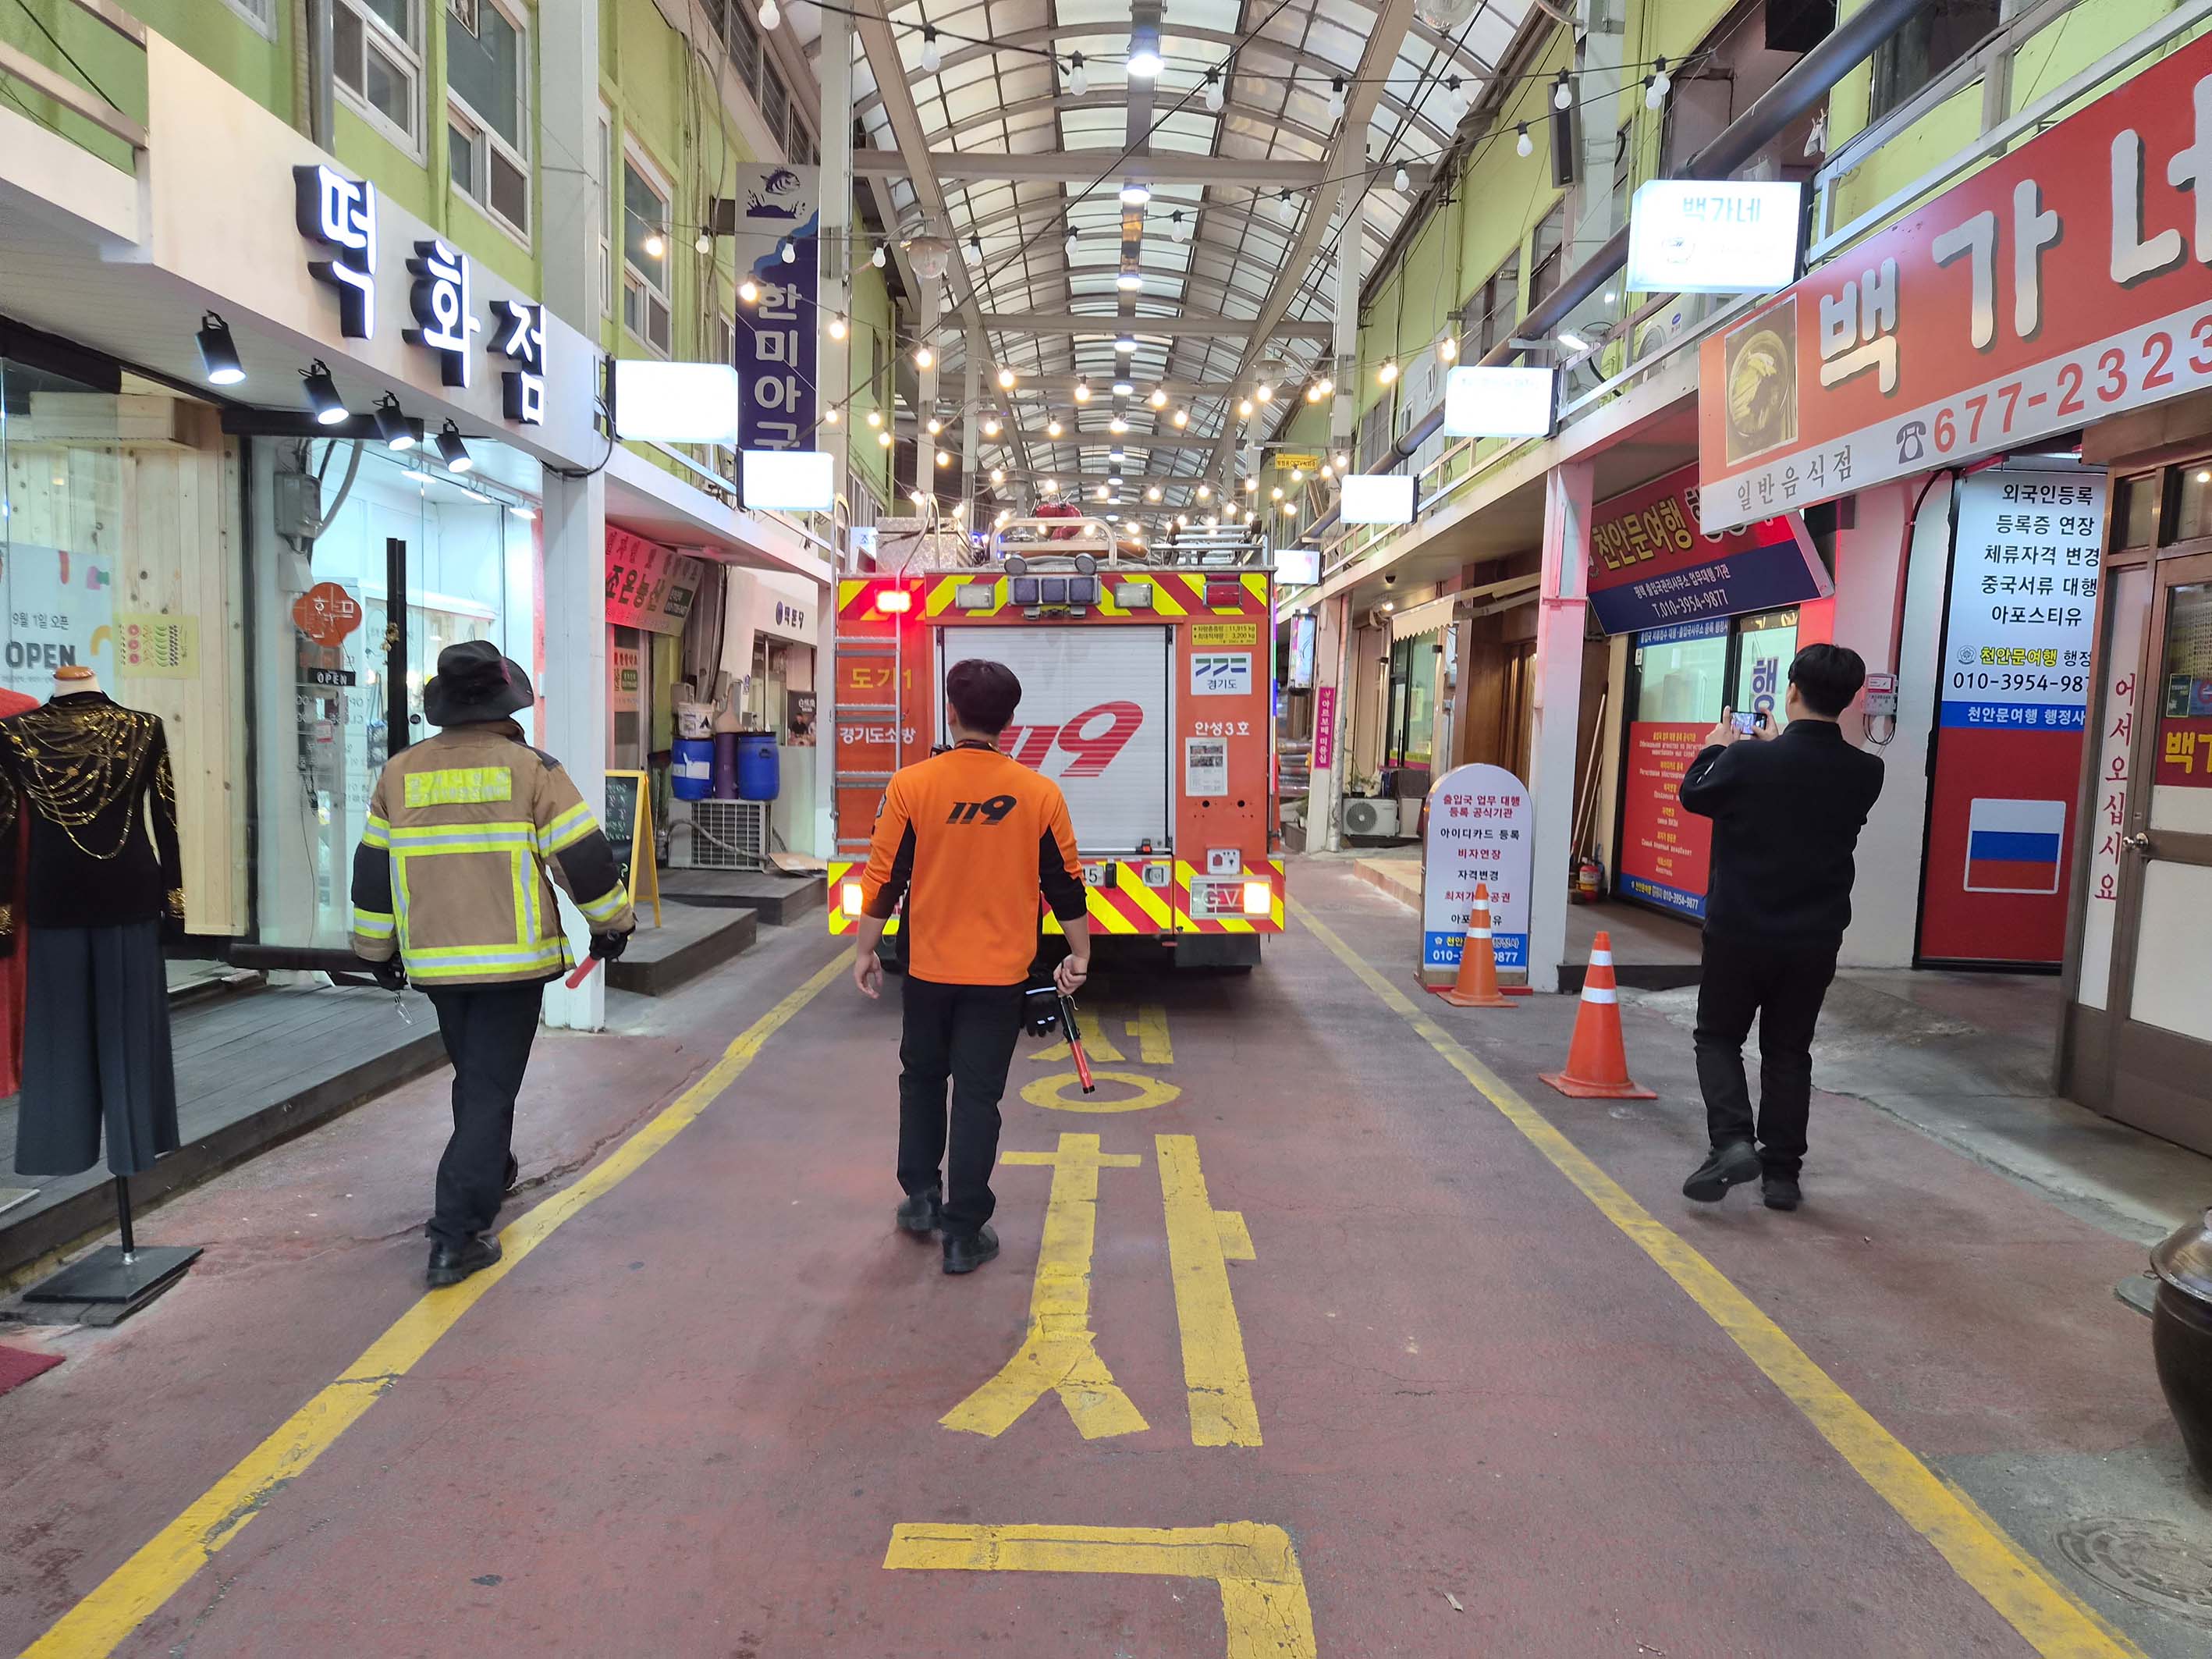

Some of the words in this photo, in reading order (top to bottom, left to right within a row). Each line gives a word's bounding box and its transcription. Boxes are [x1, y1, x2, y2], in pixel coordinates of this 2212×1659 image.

[1683, 197, 1761, 223] 백가네
[295, 164, 546, 427] 떡화점
[1933, 314, 2212, 454] 677-2323
[1738, 444, 1852, 512] 일반음식점
[2002, 484, 2093, 506] 외국인등록
[1592, 498, 1692, 570] 천안문여행
[1996, 514, 2050, 534] 등록증
[2059, 516, 2095, 536] 연장
[1984, 545, 2057, 565] 체류자격
[2066, 547, 2100, 567] 변경
[1714, 563, 1731, 579] 기관
[1981, 575, 2054, 595] 중국서류
[2063, 577, 2097, 598] 대행
[51, 615, 69, 631] 오픈
[1991, 606, 2082, 627] 아포스티유
[5, 641, 76, 669] OPEN
[1980, 646, 2058, 667] 천안문여행
[316, 672, 348, 685] OPEN
[1207, 678, 1237, 690] 경기도
[1968, 706, 2037, 725] 천안문여행
[2044, 709, 2086, 726] 행정사
[1195, 721, 1250, 736] 안성3호
[946, 794, 1017, 826] 119
[1443, 794, 1472, 805] 출입국
[1477, 794, 1497, 806] 업무
[1500, 795, 1520, 807] 대행
[1449, 807, 1468, 818] 등록
[1473, 807, 1513, 819] 공식기관
[1440, 828, 1493, 839] 아이디카드
[1499, 829, 1520, 840] 등록
[1458, 848, 1501, 860] 비자연장
[1458, 869, 1499, 881] 자격변경
[1445, 890, 1475, 902] 최저가
[1451, 914, 1503, 926] 아포유
